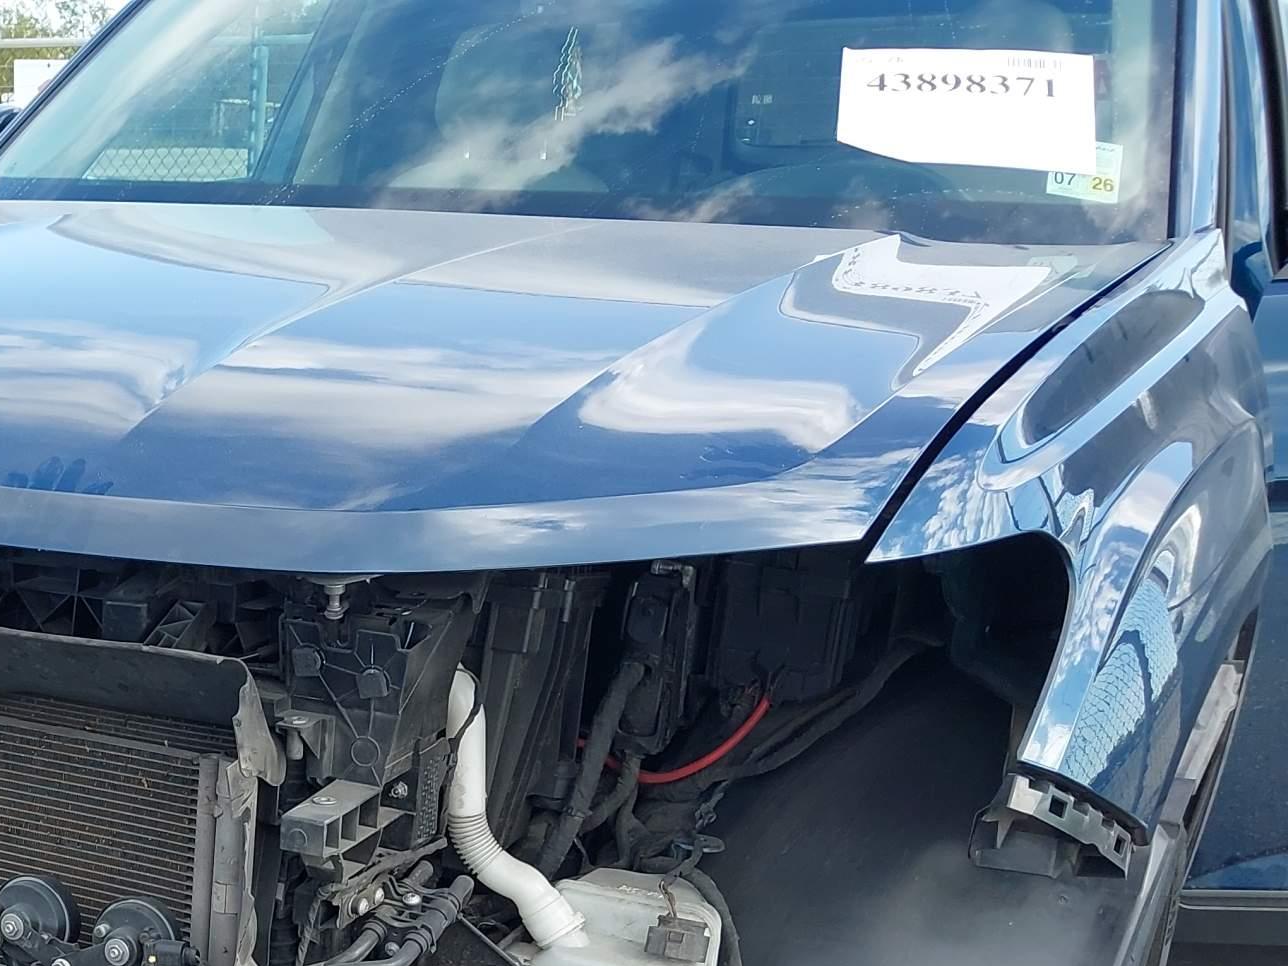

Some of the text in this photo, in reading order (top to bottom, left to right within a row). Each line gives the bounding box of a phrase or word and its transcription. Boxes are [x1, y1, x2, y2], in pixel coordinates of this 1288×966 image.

[866, 73, 1056, 98] 43898371
[1054, 171, 1114, 192] 07 26
